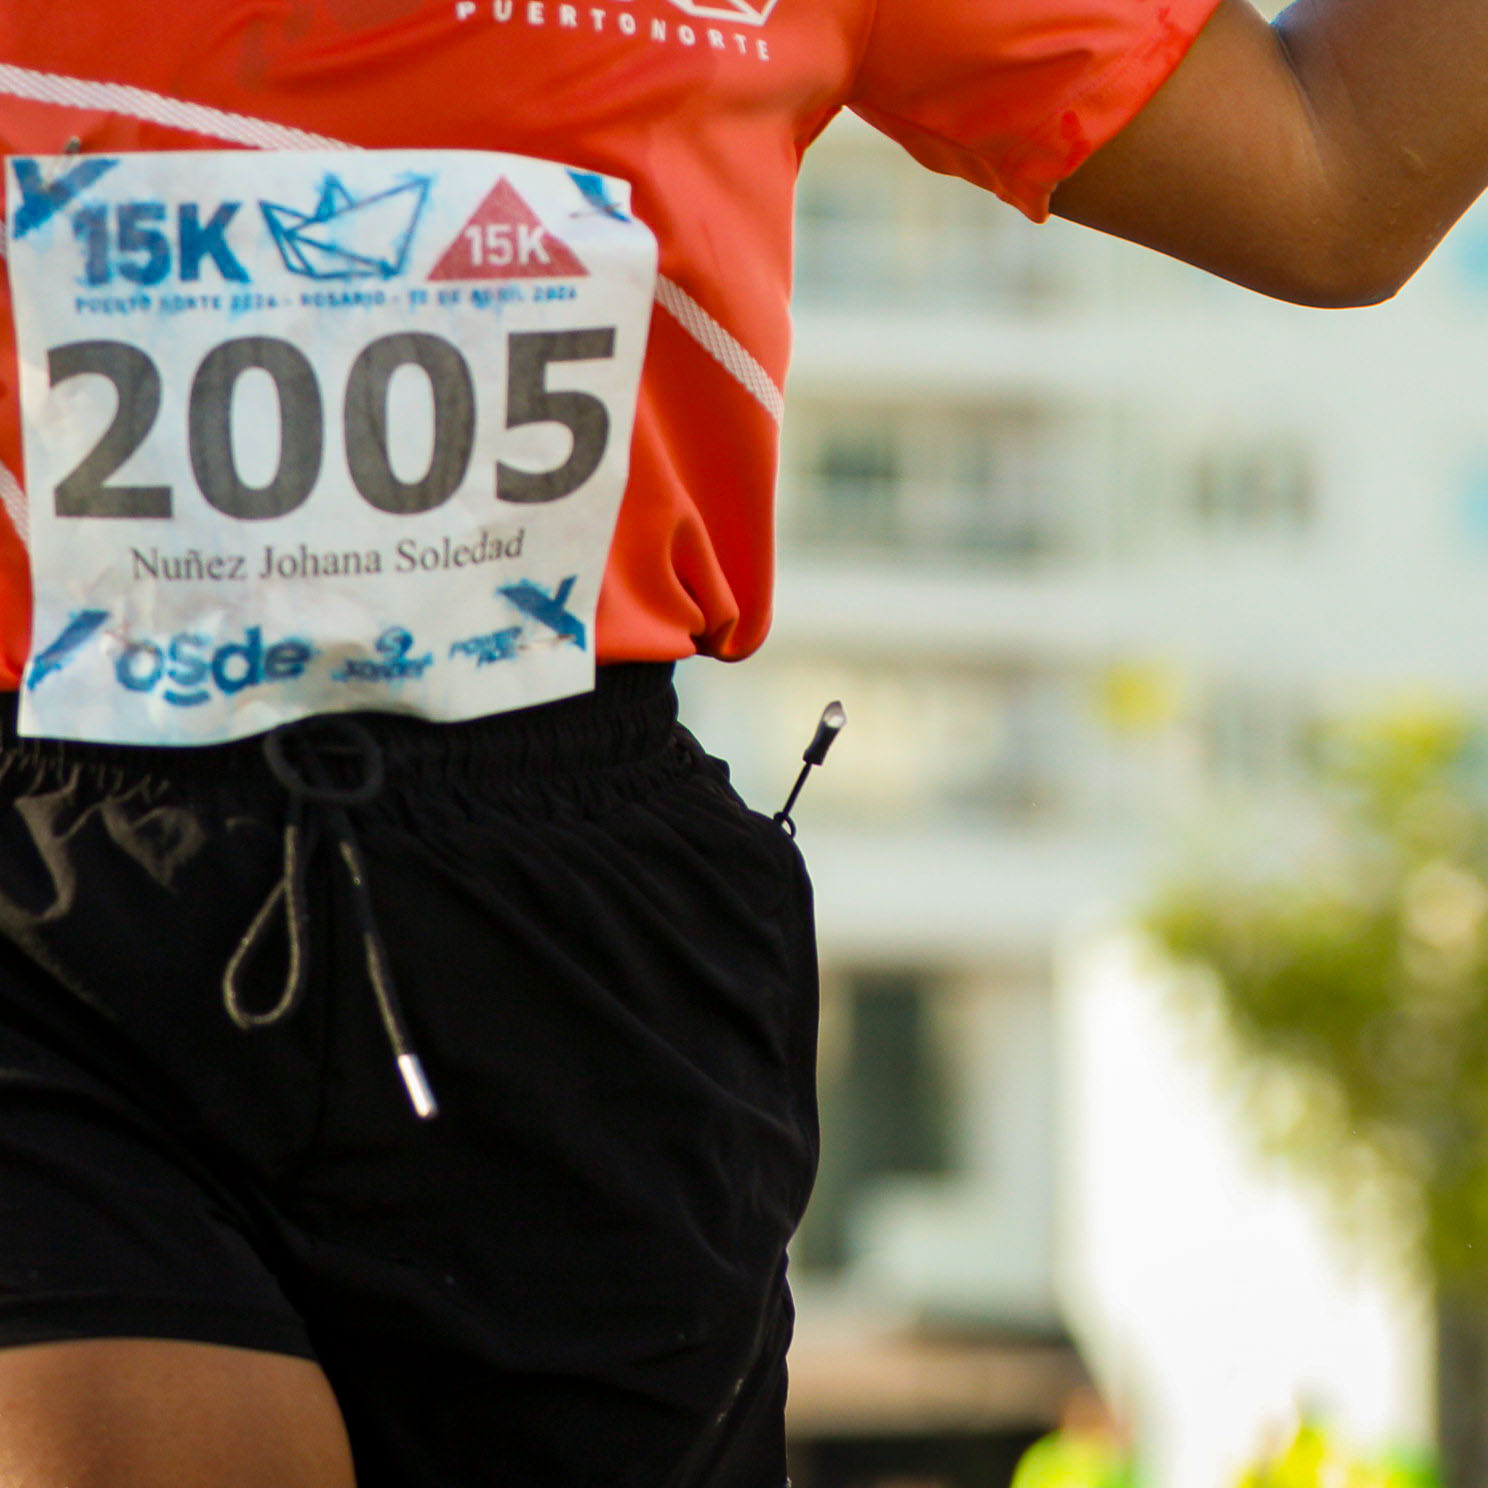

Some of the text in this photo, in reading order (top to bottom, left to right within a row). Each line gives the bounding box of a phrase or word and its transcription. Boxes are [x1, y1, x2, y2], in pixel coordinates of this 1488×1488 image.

[71, 200, 251, 286] 15K
[464, 222, 551, 267] 15K
[47, 327, 616, 521] 2005
[130, 529, 526, 581] Nuñez Johana Soledad
[115, 625, 312, 696] osde
